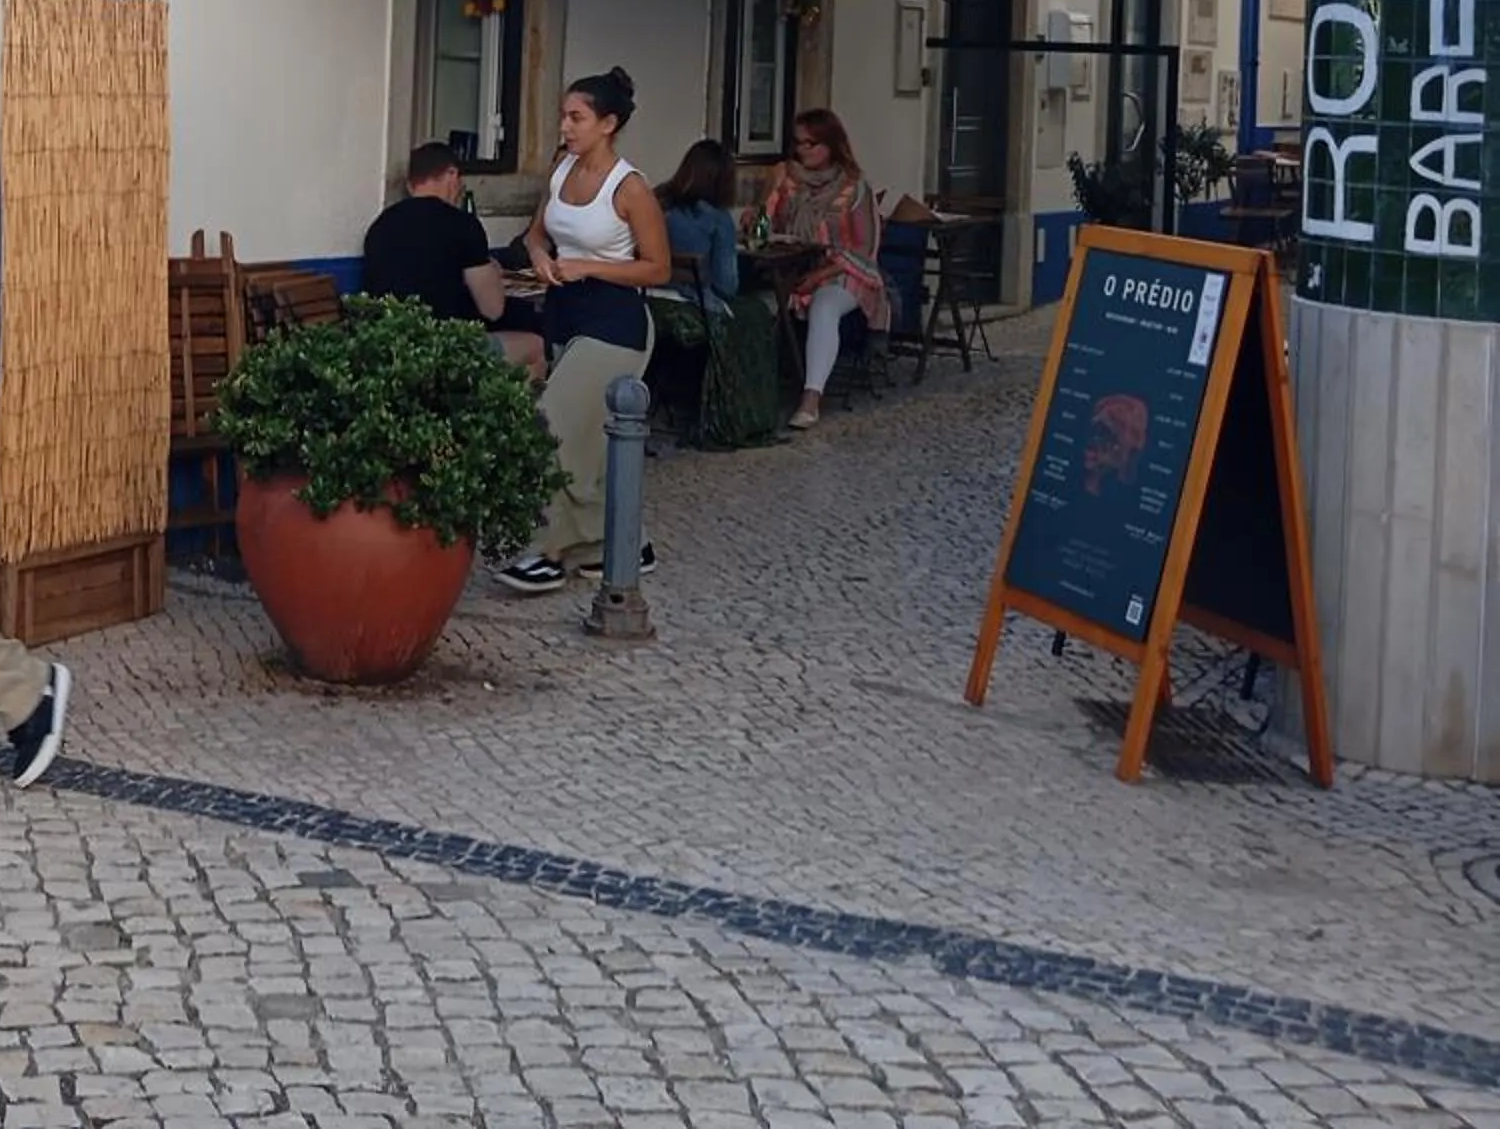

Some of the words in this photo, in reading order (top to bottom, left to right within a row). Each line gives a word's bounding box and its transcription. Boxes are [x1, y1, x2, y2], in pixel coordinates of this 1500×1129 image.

[1404, 64, 1488, 258] BAR
[1103, 274, 1118, 297] O
[1121, 278, 1194, 313] PRÉDIO
